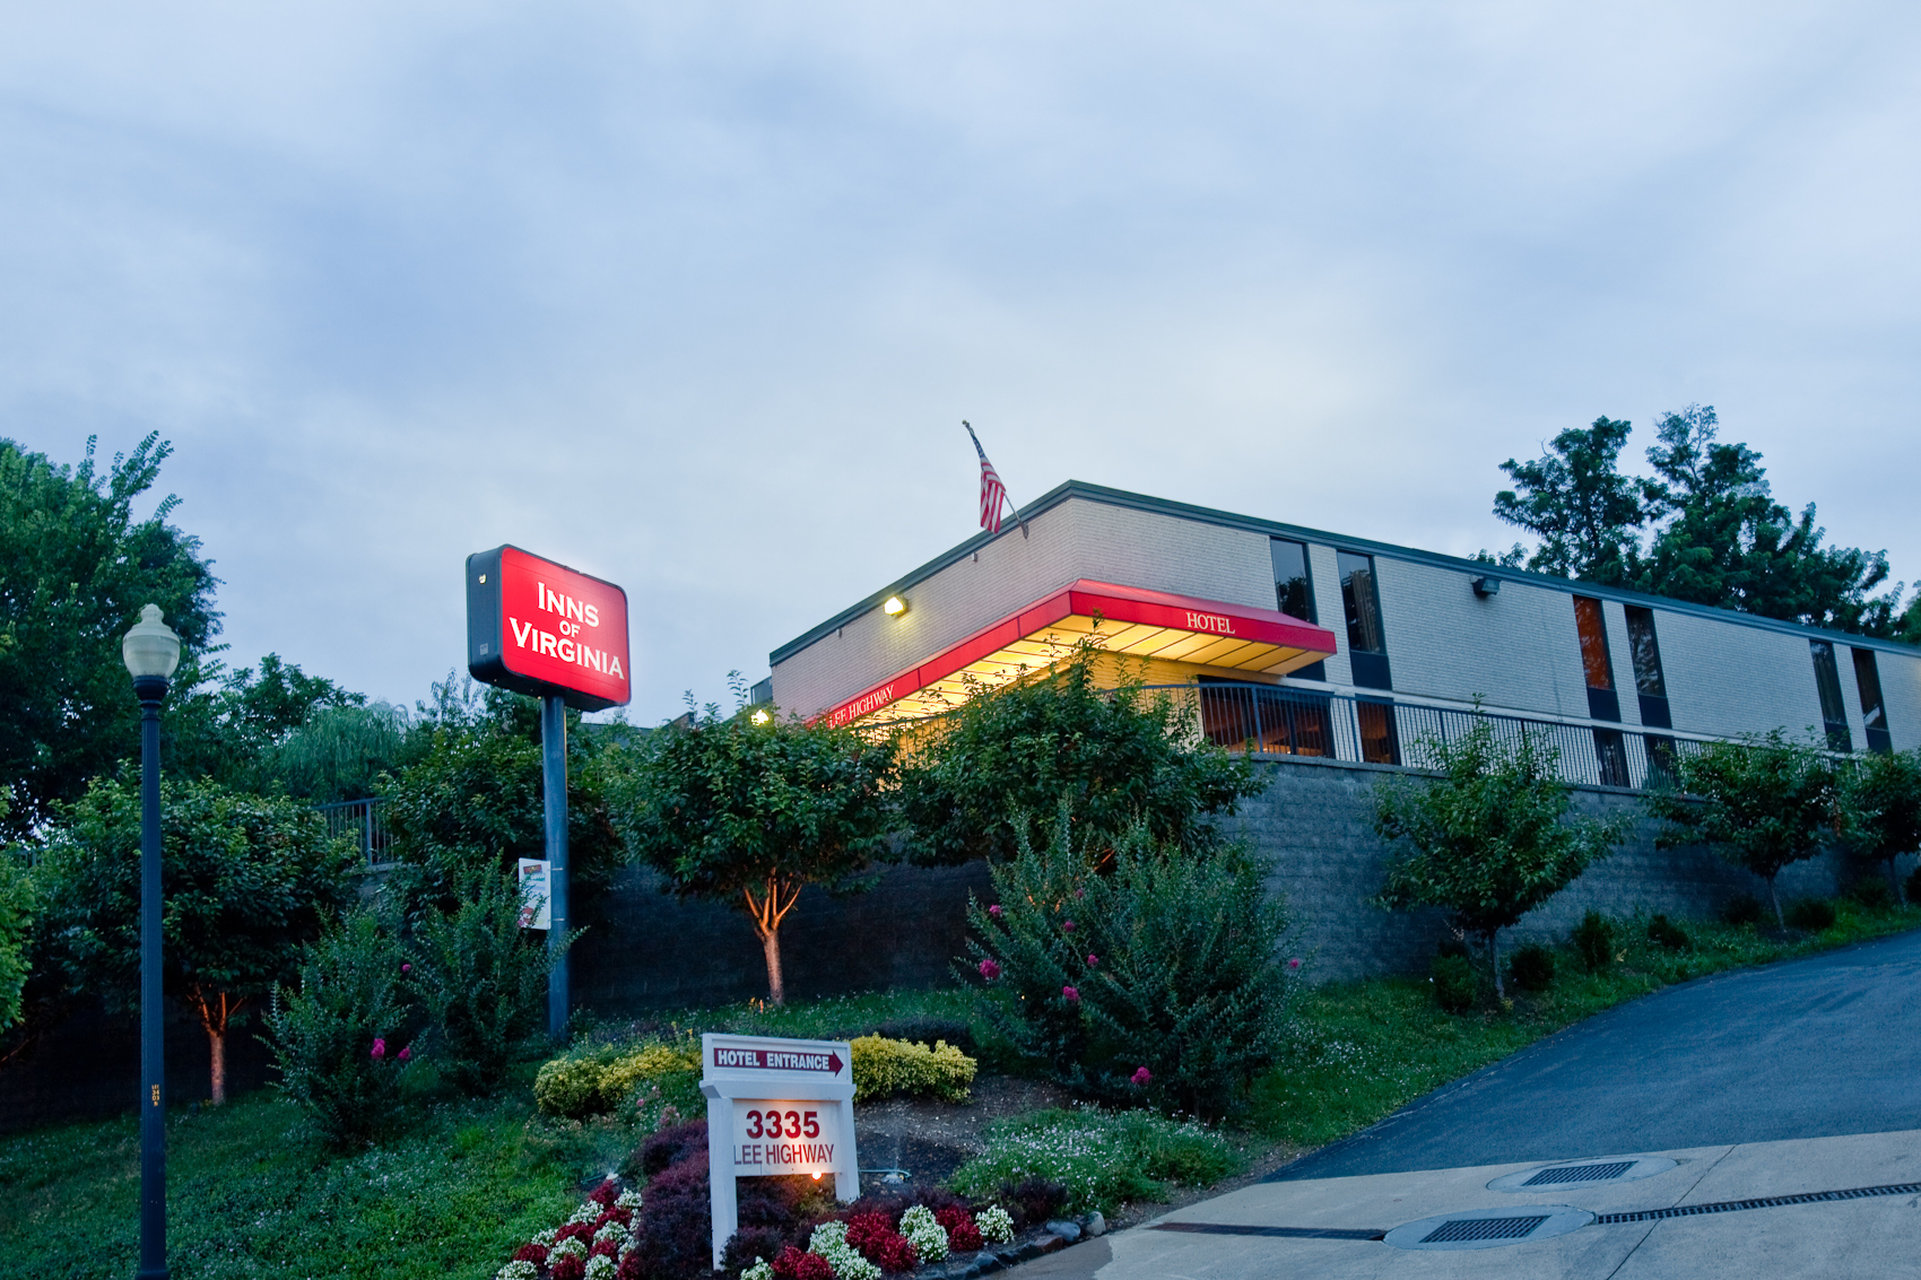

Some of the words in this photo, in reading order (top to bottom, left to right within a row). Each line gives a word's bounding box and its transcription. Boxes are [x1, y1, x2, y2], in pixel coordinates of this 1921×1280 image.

[537, 581, 600, 628] INNS
[559, 620, 581, 639] OF
[1185, 611, 1236, 635] HOTEL
[509, 616, 625, 680] VIRGINIA
[848, 683, 895, 721] HIGHWAY
[717, 1049, 761, 1067] HOTEL
[766, 1052, 830, 1071] ENTRANCE
[745, 1109, 820, 1140] 3335
[733, 1143, 763, 1166] LEE
[765, 1143, 835, 1165] HIGHWAY
